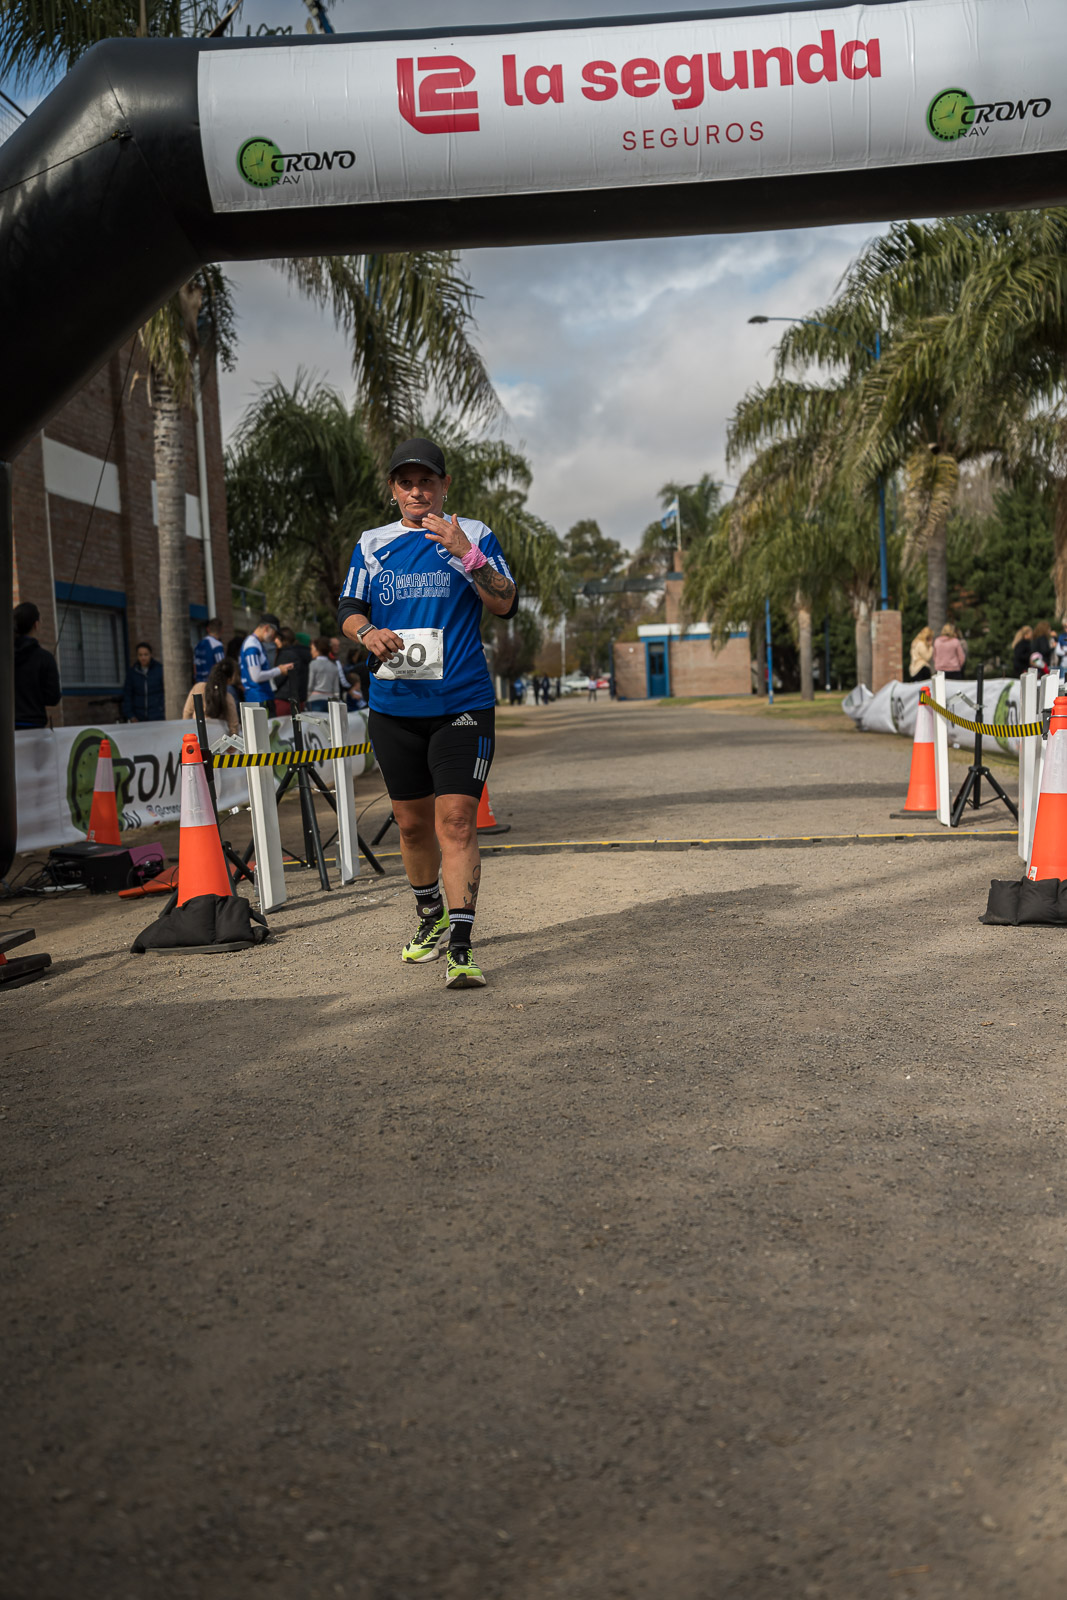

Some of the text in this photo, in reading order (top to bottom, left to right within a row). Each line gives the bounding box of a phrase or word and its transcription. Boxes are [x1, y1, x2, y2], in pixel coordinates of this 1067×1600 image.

[502, 29, 882, 111] la segunda
[961, 97, 1051, 125] CRONO
[622, 120, 764, 151] SEGUROS
[958, 126, 989, 138] RAV
[271, 150, 355, 173] CRONO
[271, 174, 301, 186] RAV
[379, 569, 451, 606] 3 MARATÓN
